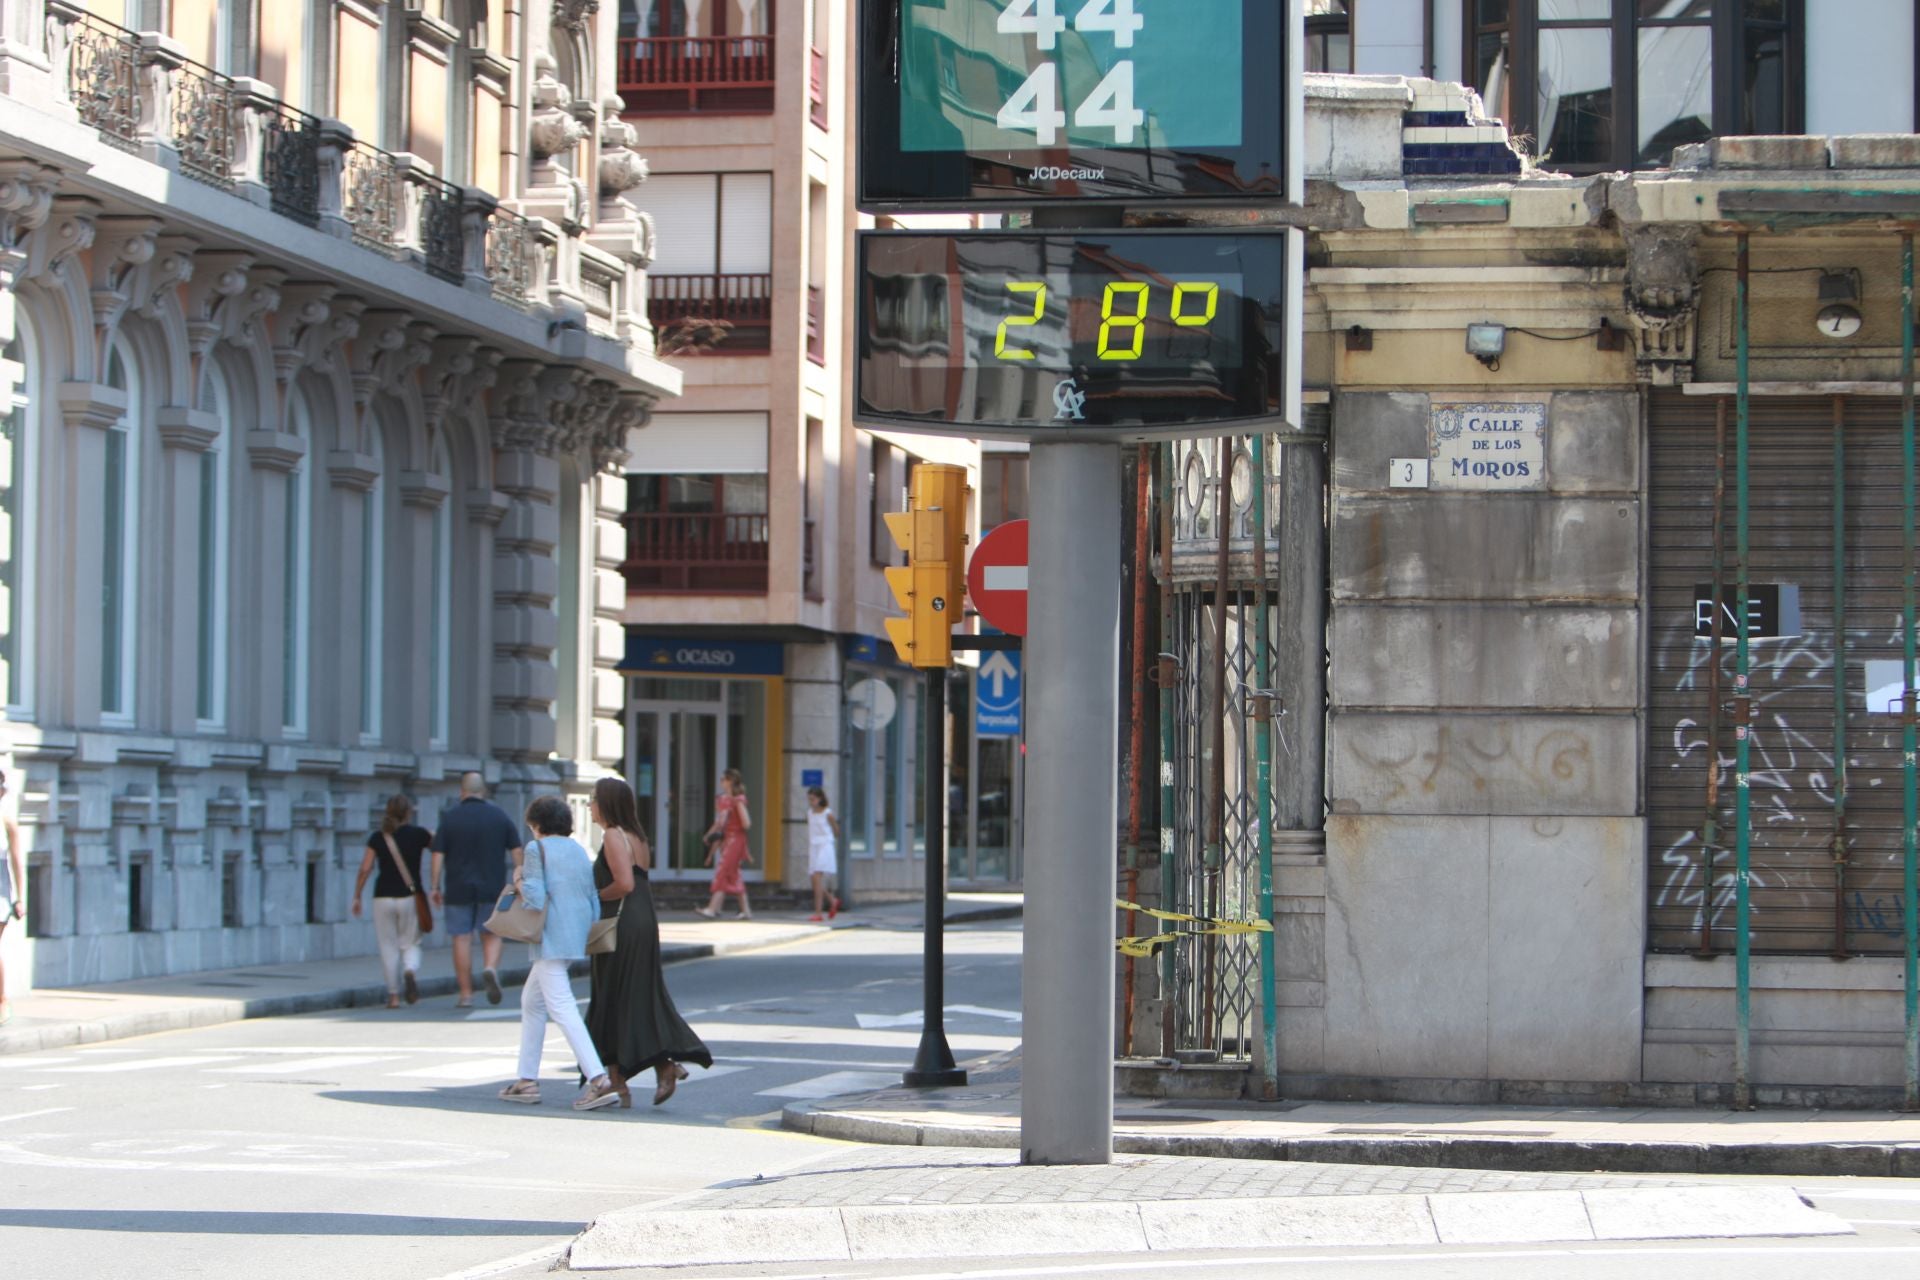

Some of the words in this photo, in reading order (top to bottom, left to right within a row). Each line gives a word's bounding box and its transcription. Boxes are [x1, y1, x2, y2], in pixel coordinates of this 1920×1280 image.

[997, 60, 1144, 145] 44
[1029, 166, 1105, 180] JCDecaux
[1468, 418, 1523, 432] CALLE
[1472, 440, 1490, 450] DE
[1495, 439, 1522, 450] LOS
[1404, 463, 1413, 482] 3
[1452, 457, 1530, 480] MOROS
[676, 648, 736, 665] OCASO
